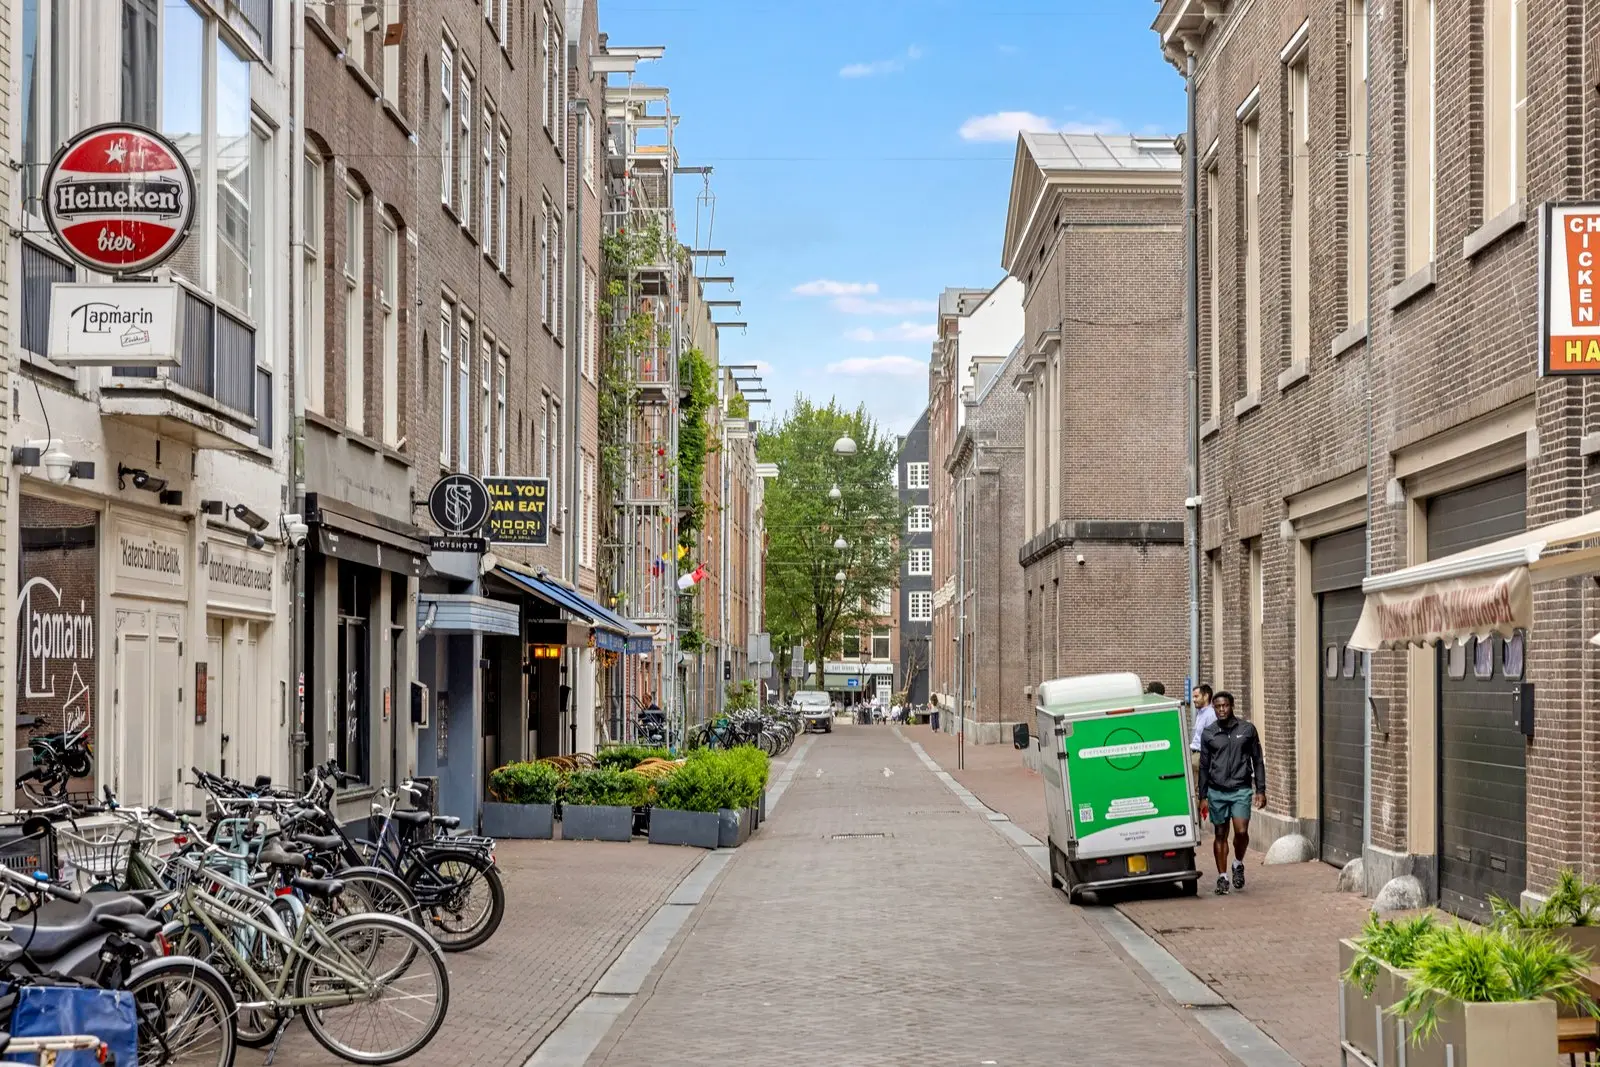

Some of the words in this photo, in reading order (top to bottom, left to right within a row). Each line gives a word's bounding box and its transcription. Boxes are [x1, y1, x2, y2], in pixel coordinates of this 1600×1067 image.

[59, 184, 177, 211] Heineken
[97, 227, 136, 252] bier
[71, 302, 153, 333] Tapmarin
[487, 484, 512, 496] ALL
[516, 485, 545, 497] YOU
[518, 501, 546, 513] EAT
[490, 520, 541, 530] NOORI
[16, 577, 94, 698] Tapmarin
